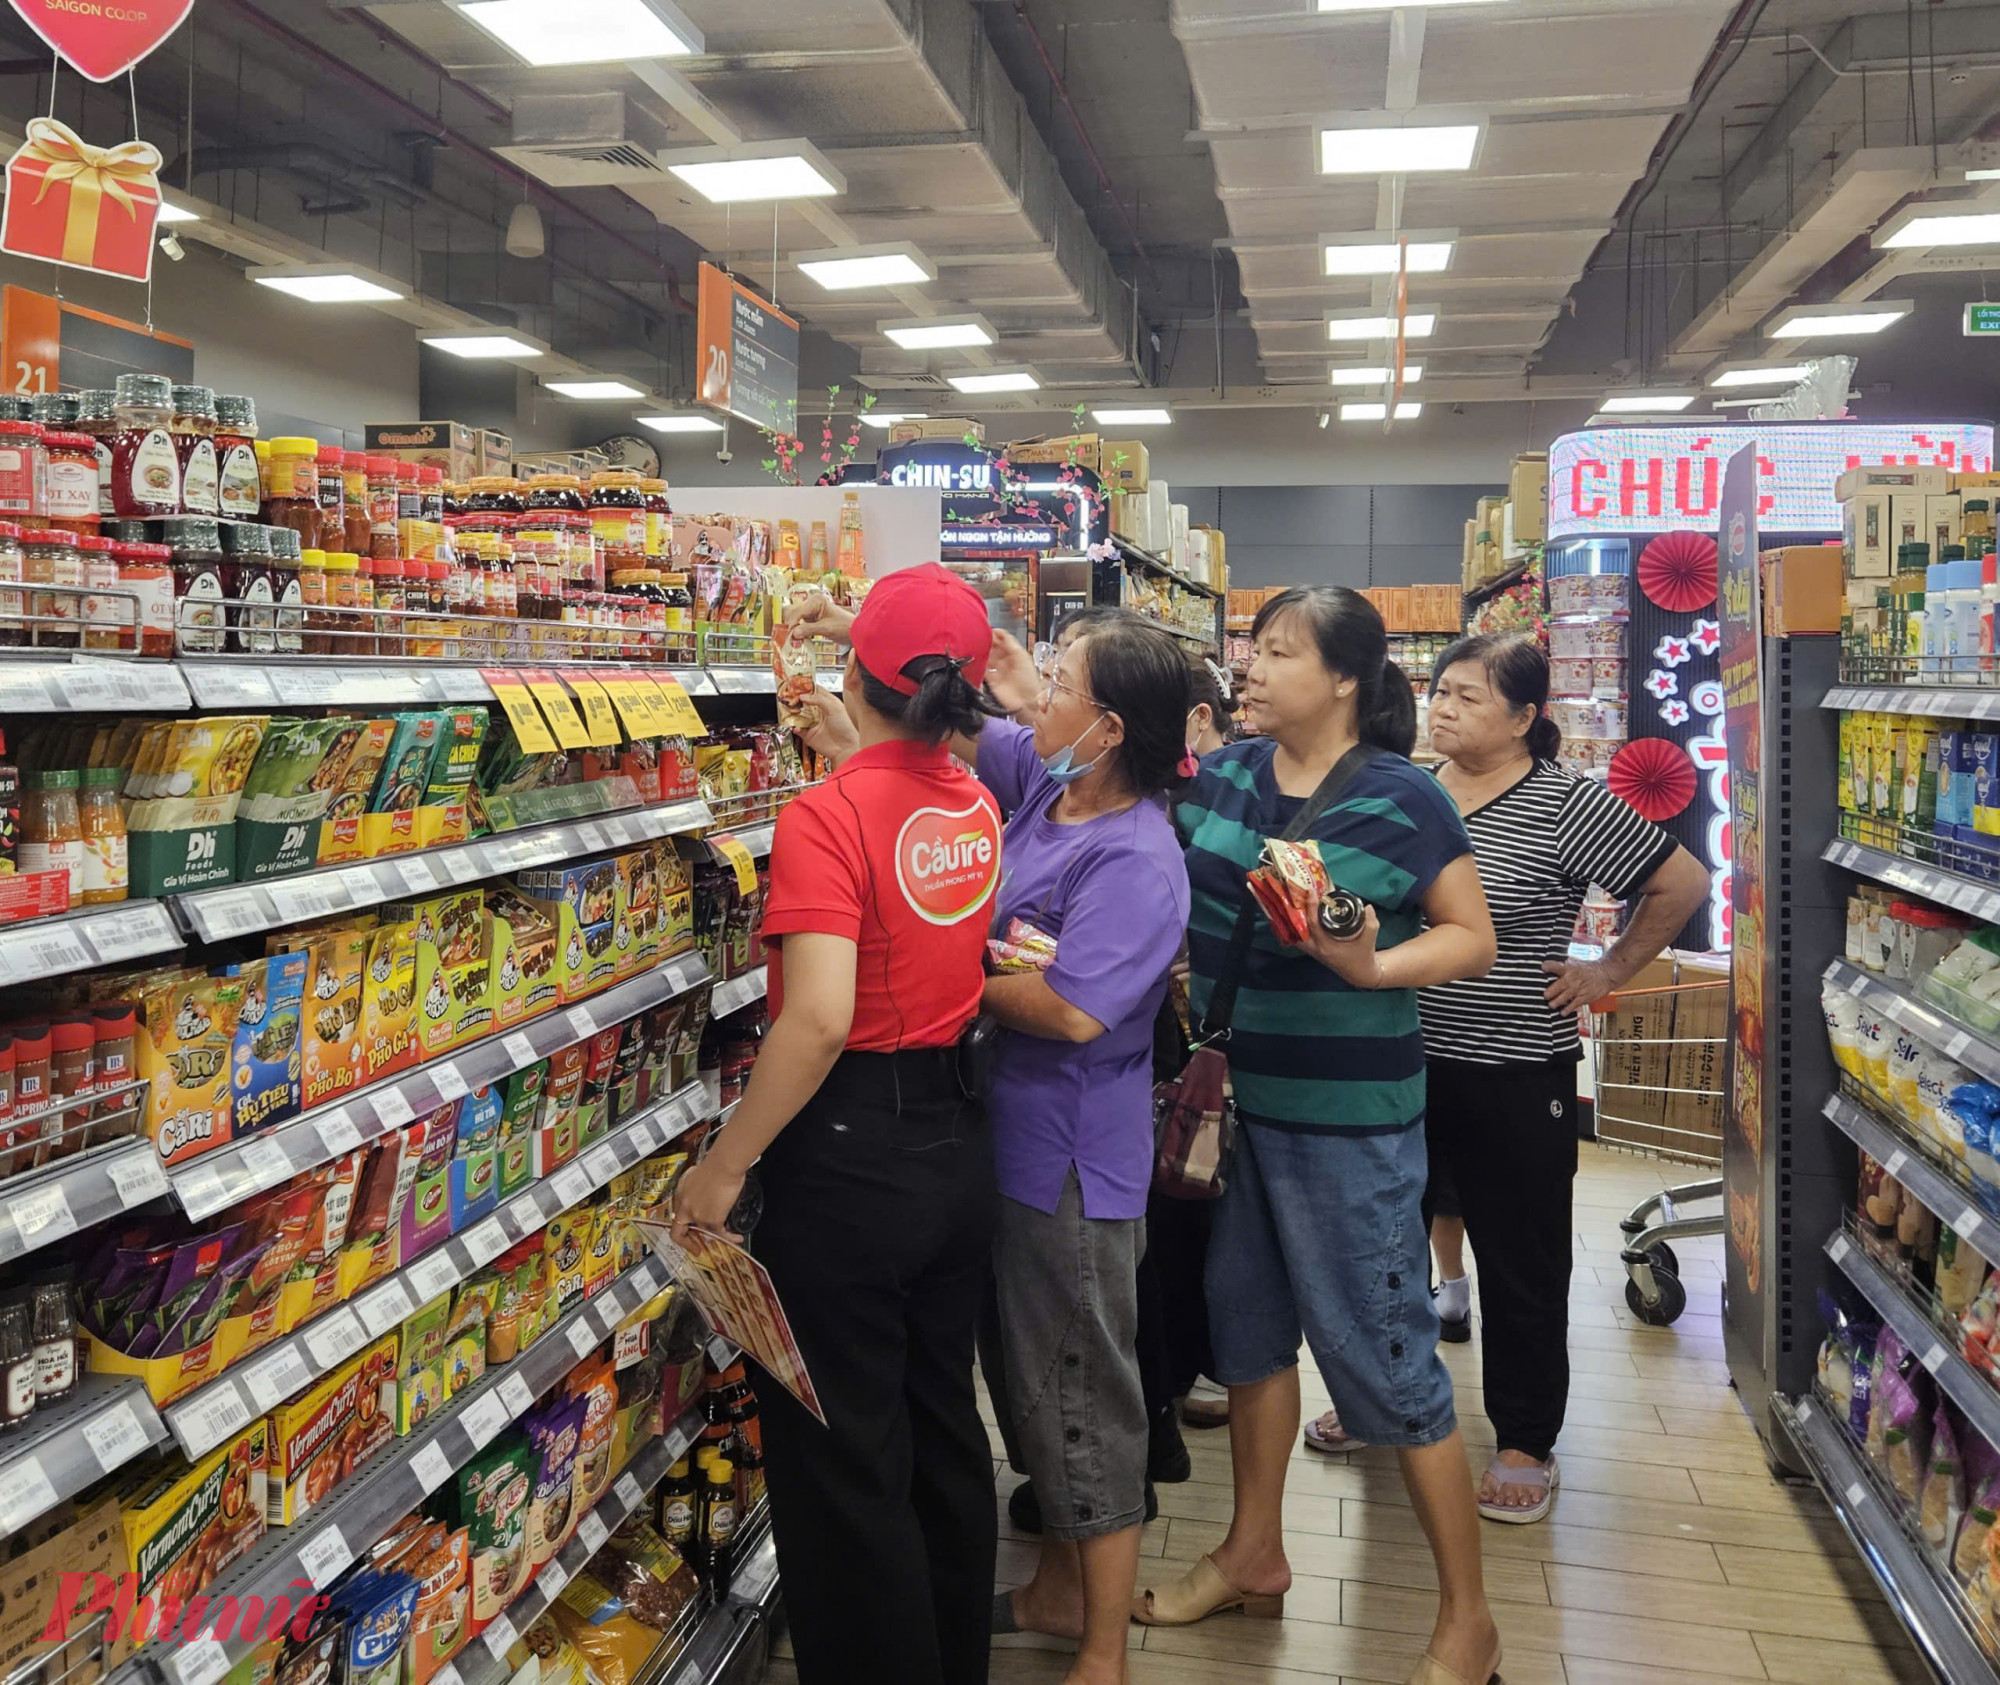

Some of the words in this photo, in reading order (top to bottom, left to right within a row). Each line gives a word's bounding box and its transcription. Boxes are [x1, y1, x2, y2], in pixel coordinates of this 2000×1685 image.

[45, 0, 101, 16] SAIGON
[1980, 321, 2000, 329] EXI
[15, 361, 47, 396] 21
[704, 344, 728, 397] 20
[378, 428, 430, 445] Omachi
[891, 464, 991, 490] CHIN-SU
[68, 489, 93, 501] XAY
[958, 533, 987, 543] NGON
[186, 831, 217, 861] Dh
[280, 825, 309, 851] Dh
[276, 850, 300, 861] Foods
[185, 860, 213, 870] Foods
[178, 873, 189, 887] Vị
[187, 871, 208, 885] Hoàn
[38, 1356, 54, 1366] HOA
[667, 1514, 683, 1524] Dầu
